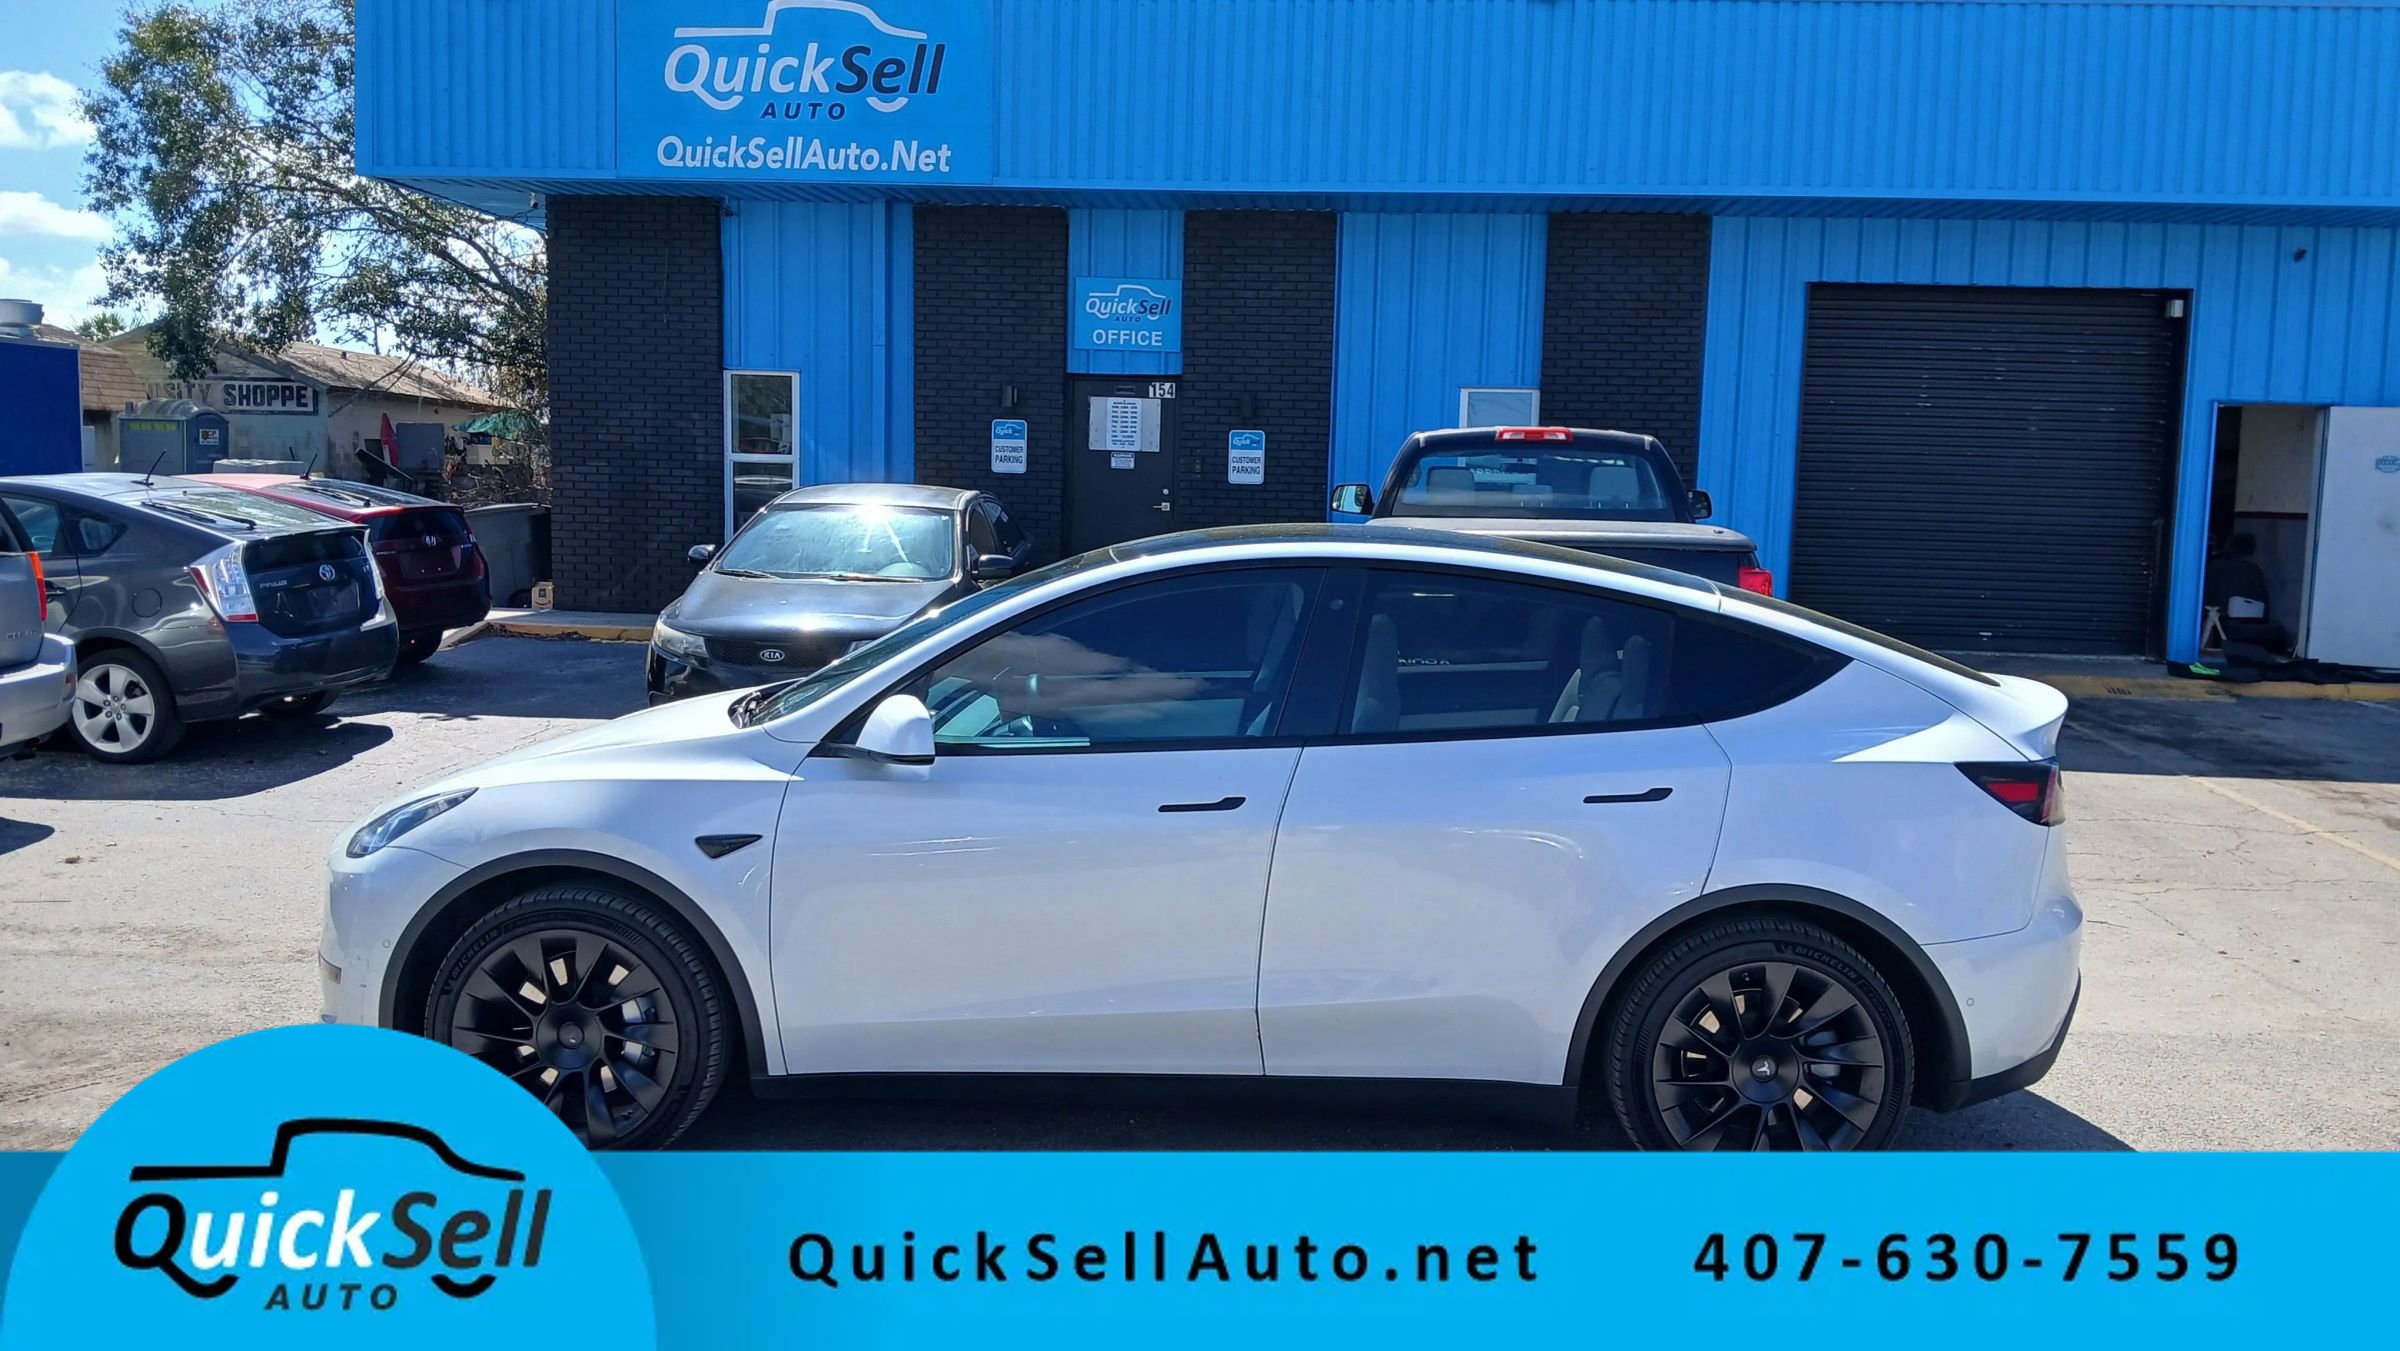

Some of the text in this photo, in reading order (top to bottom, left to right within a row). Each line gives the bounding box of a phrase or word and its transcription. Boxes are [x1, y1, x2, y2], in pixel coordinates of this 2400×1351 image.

[664, 42, 946, 112] QuickSell
[760, 102, 846, 120] AUTO
[657, 135, 952, 173] QuickSellAuto.Net
[1085, 297, 1172, 320] QuickSell
[1115, 315, 1142, 323] AUTO
[1092, 328, 1163, 346] OFFICE
[223, 383, 309, 408] SHOPPE
[1151, 383, 1174, 398] 154
[994, 445, 1024, 454] CUSTOMER
[994, 454, 1024, 464] PARKING
[1231, 456, 1261, 464] CUSTOMER
[1231, 465, 1261, 475] PARKING
[451, 928, 499, 980] MICHELIN
[1795, 945, 1858, 980] MICHELIN
